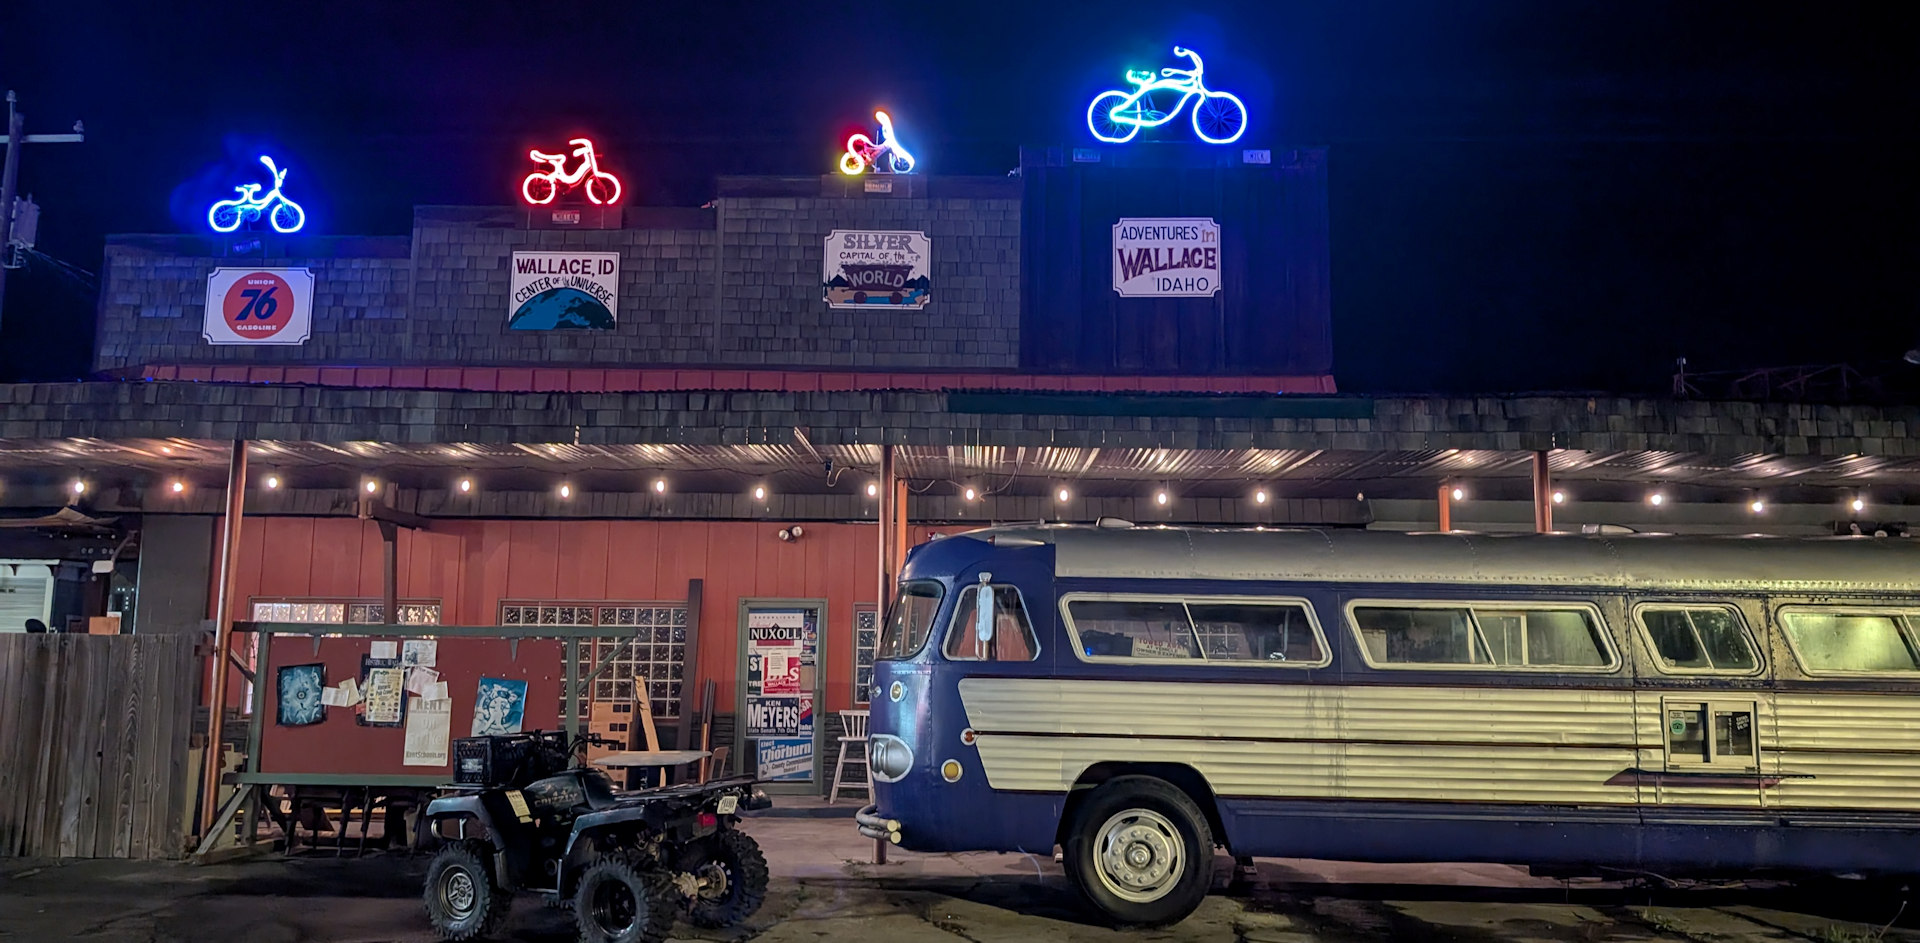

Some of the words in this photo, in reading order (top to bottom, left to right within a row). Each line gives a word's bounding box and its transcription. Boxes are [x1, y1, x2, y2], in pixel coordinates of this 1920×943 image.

[1120, 226, 1198, 240] ADVENTURES
[843, 233, 917, 254] SILVER
[839, 251, 875, 260] CAPITAL
[878, 252, 889, 260] OF
[1116, 247, 1217, 283] WALLACE
[516, 258, 596, 278] WALLACE,
[598, 259, 615, 275] ID
[847, 270, 905, 288] WORLD
[1157, 277, 1209, 292] IDAHO
[515, 276, 553, 303] CENTER
[235, 286, 279, 321] 76
[751, 628, 801, 640] NUXOLL
[747, 703, 798, 728] MEYERS
[760, 743, 812, 762] Thorburn
